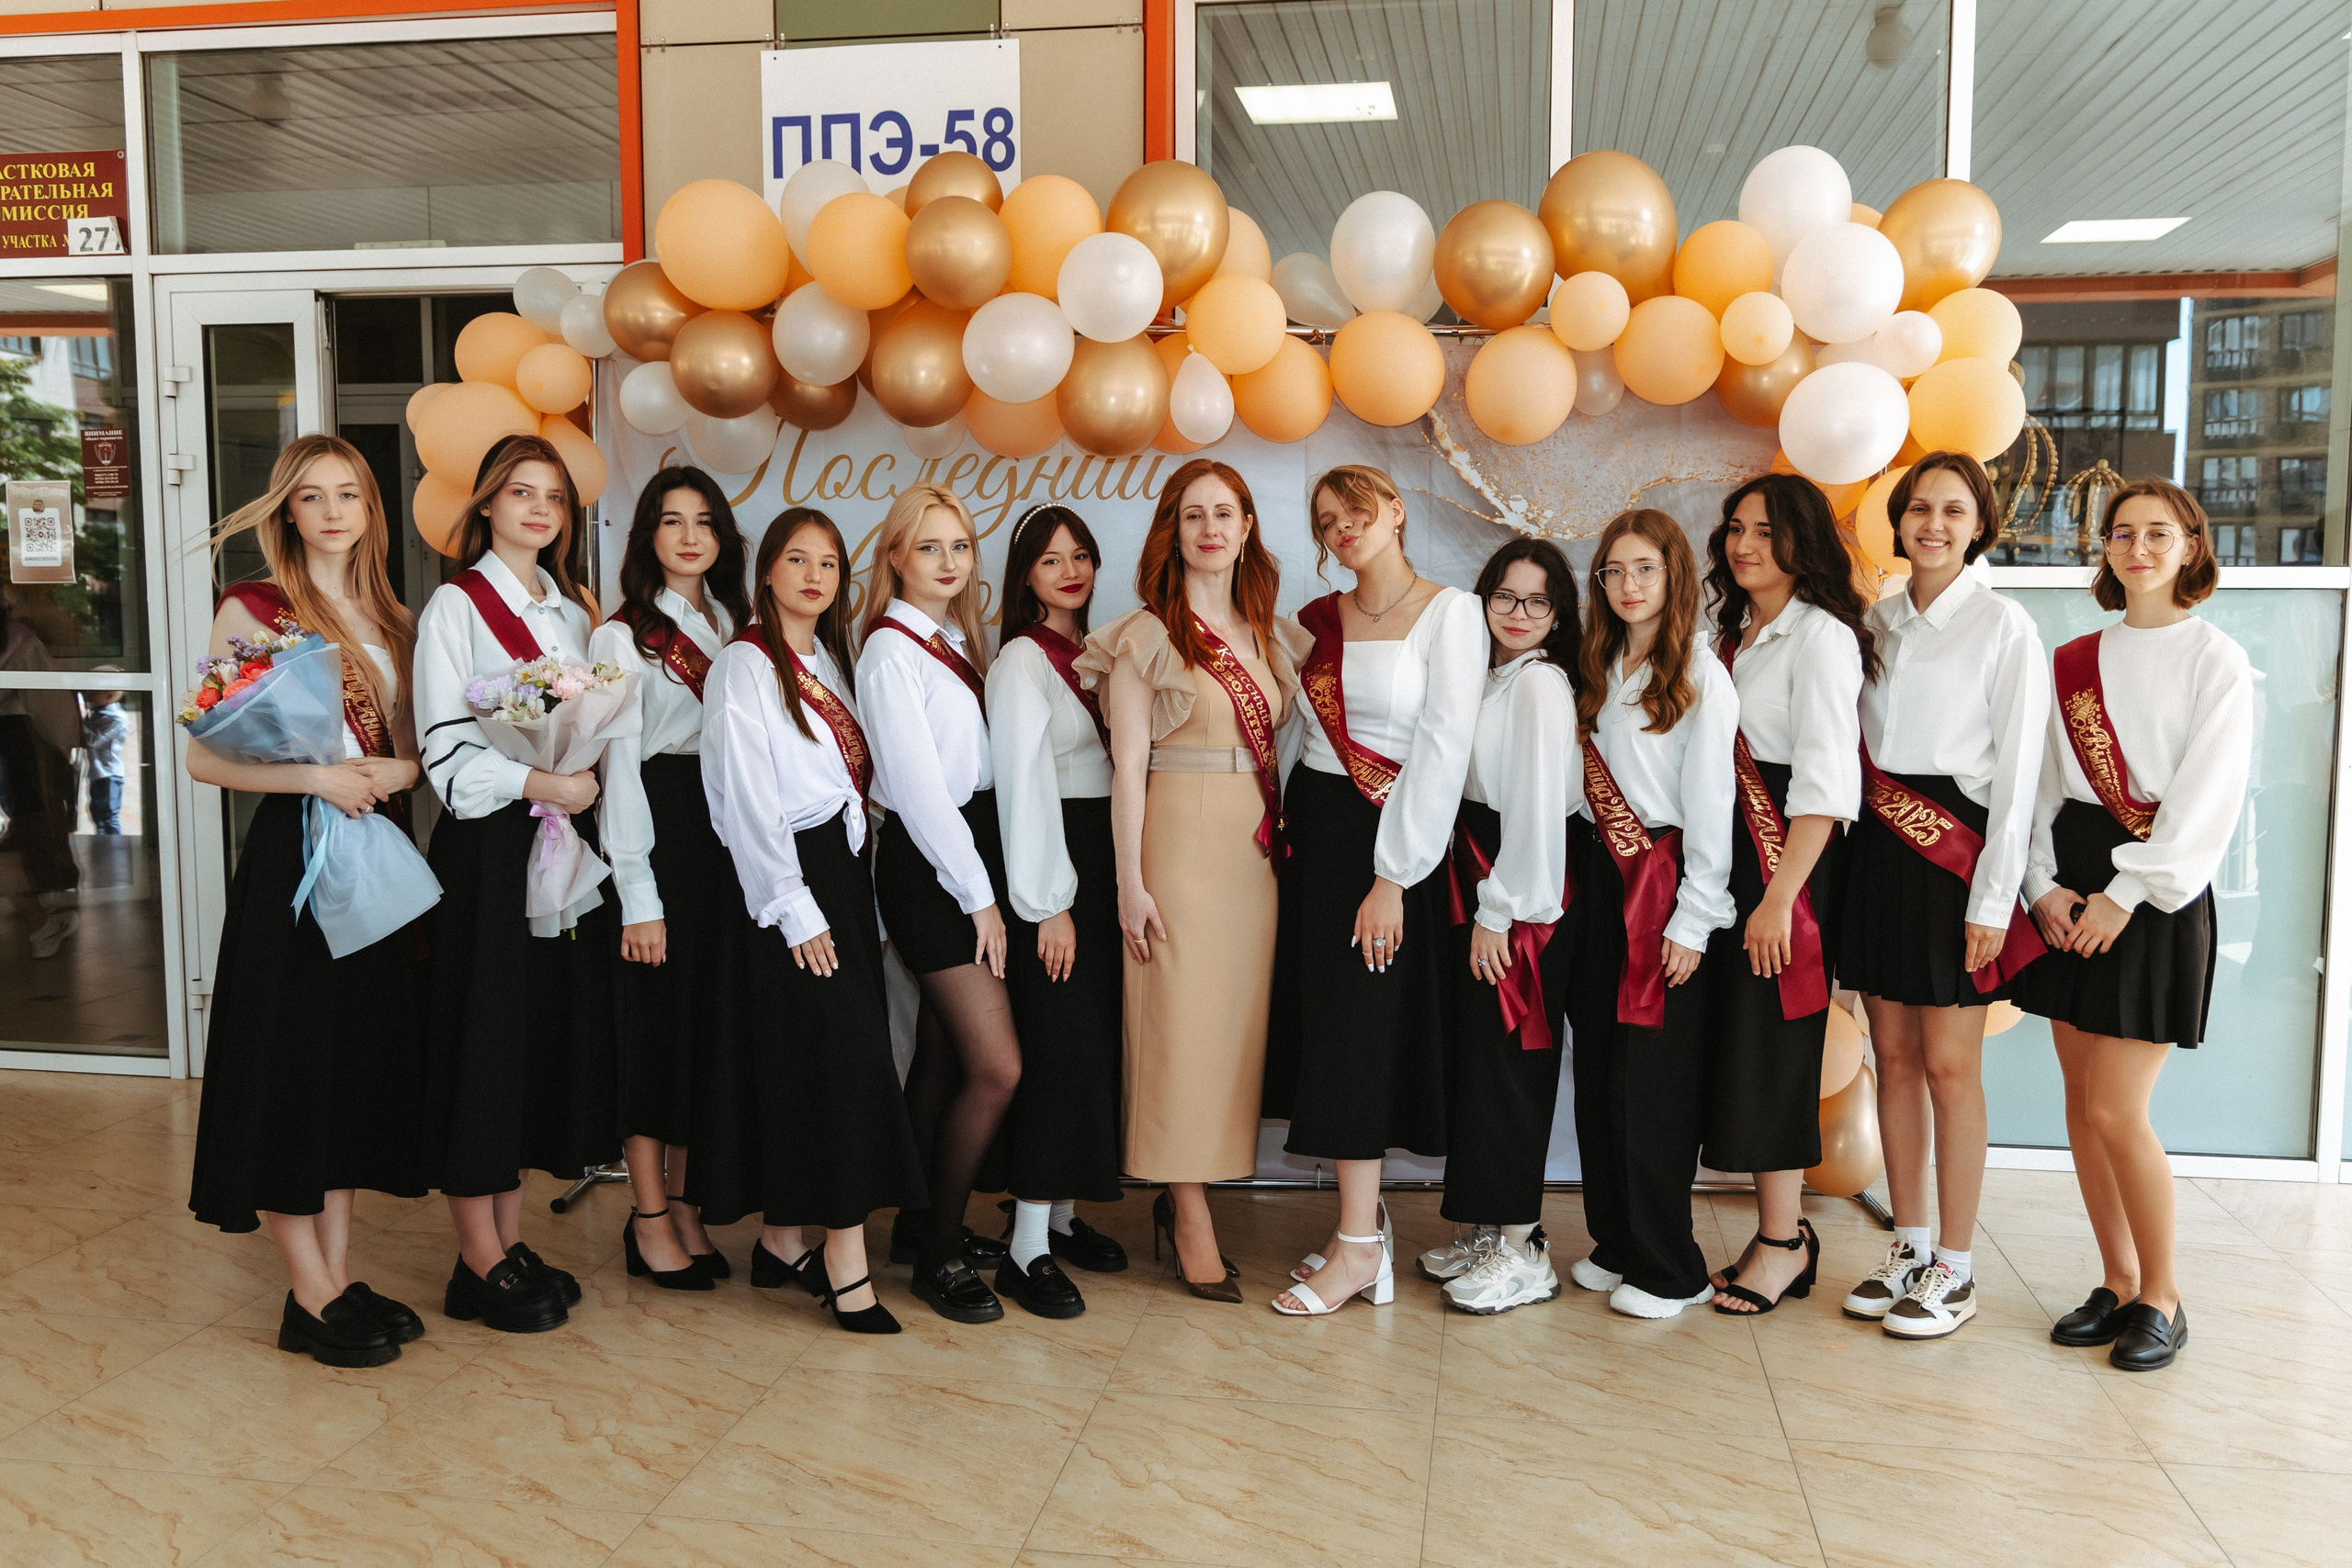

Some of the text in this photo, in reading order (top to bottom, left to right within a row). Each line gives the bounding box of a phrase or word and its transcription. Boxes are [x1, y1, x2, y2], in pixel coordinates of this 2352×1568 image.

[772, 107, 1016, 179] ППЭ-58
[0, 182, 114, 201] РАТЕЛЬНАЯ
[1, 204, 89, 221] МИССИЯ
[2, 234, 57, 249] УЧАСТКА
[1211, 660, 1269, 763] ОВОДИТЕЛЬ
[1216, 644, 1272, 727] Классный
[1595, 795, 1653, 856] 2025
[1878, 791, 1953, 847] 2025
